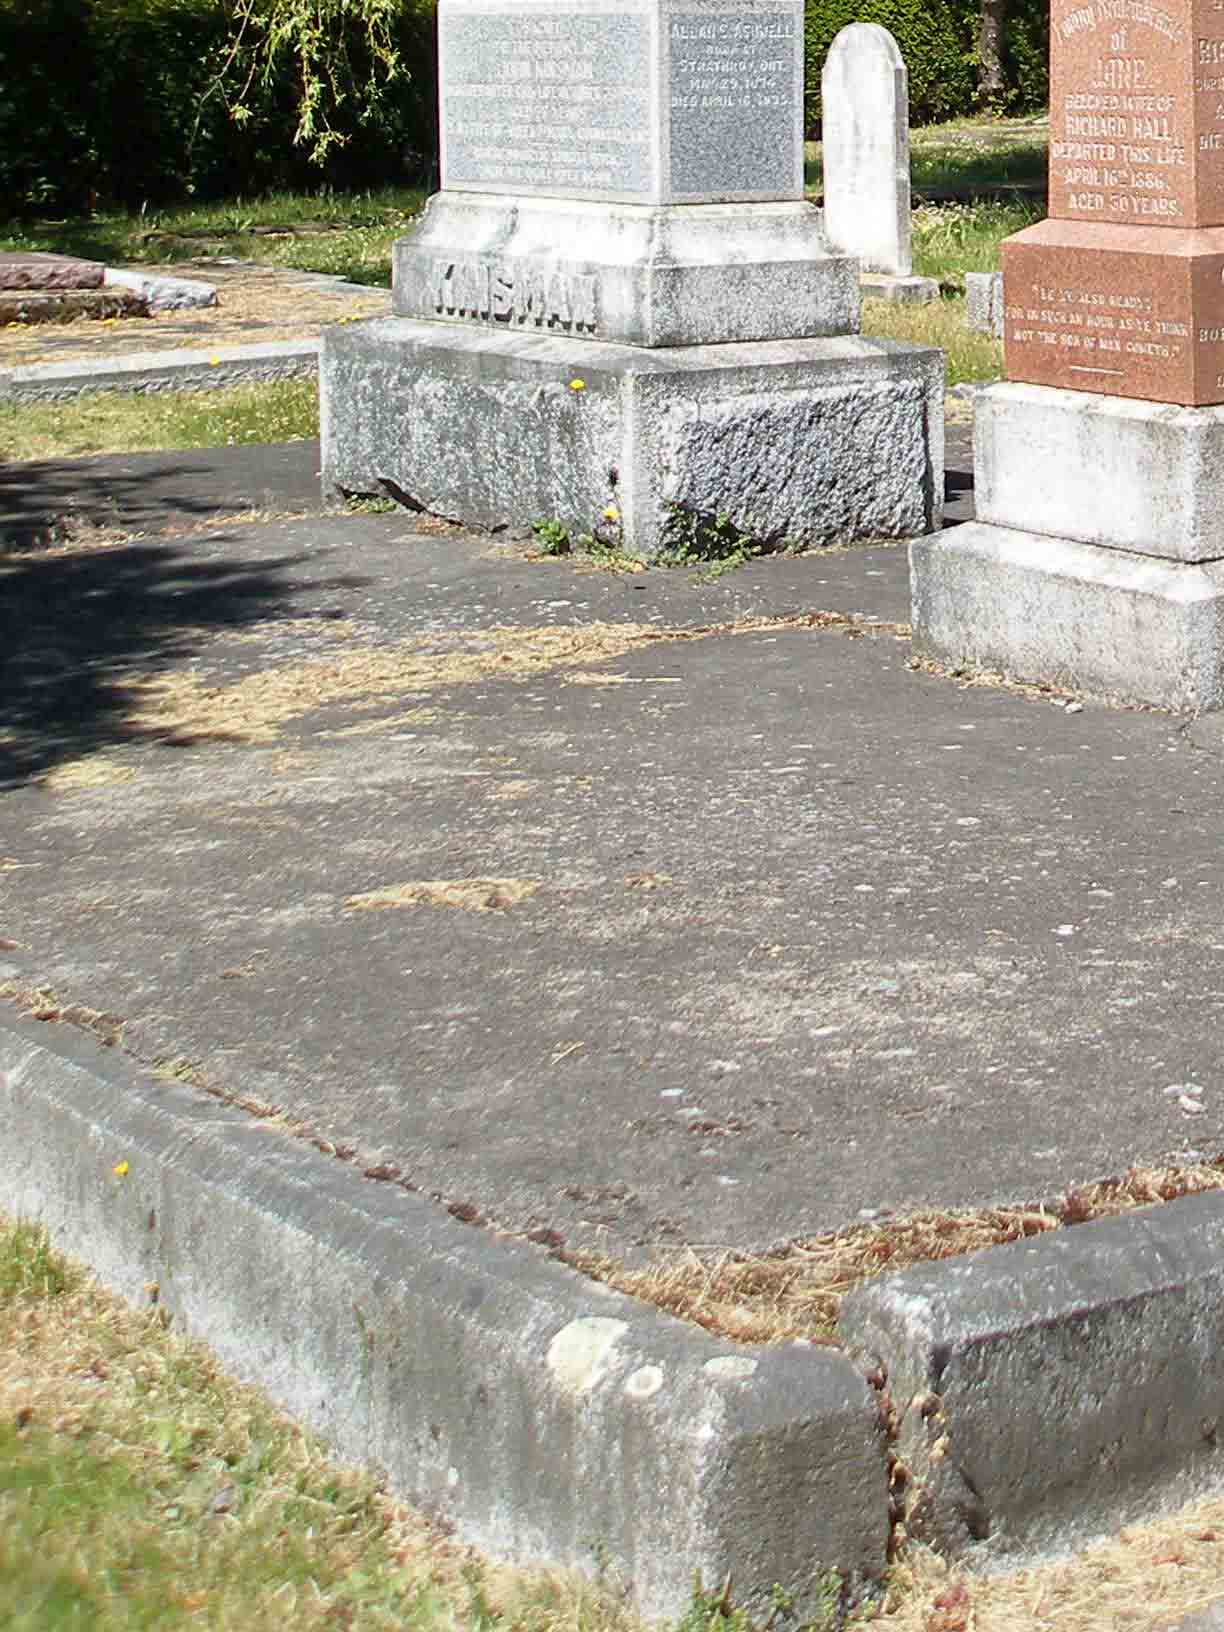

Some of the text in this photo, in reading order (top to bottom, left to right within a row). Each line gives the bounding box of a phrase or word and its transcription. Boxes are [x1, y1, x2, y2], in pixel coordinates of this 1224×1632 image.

[1065, 115, 1128, 137] RICHARD
[1051, 142, 1117, 161] DEPARTED
[433, 260, 598, 332] KINSMAN
